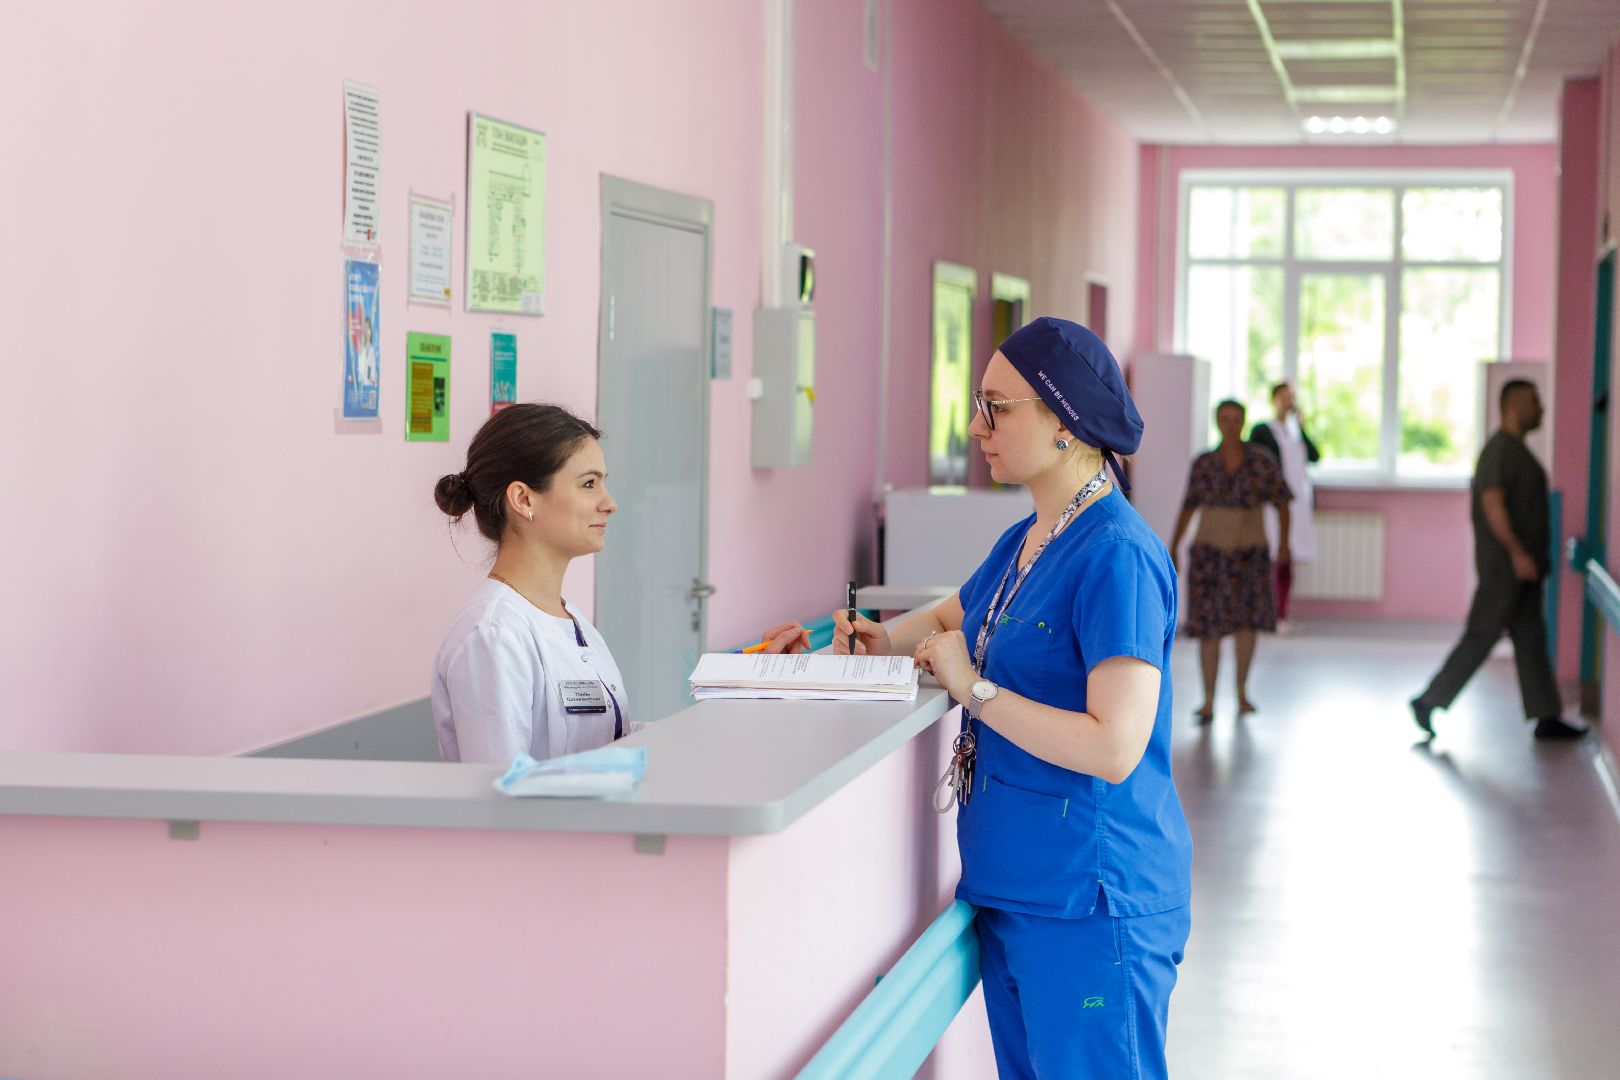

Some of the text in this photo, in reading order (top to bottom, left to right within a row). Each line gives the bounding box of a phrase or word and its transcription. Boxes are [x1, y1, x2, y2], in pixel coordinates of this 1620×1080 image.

[1038, 371, 1079, 421] WE CAN BE HEROES
